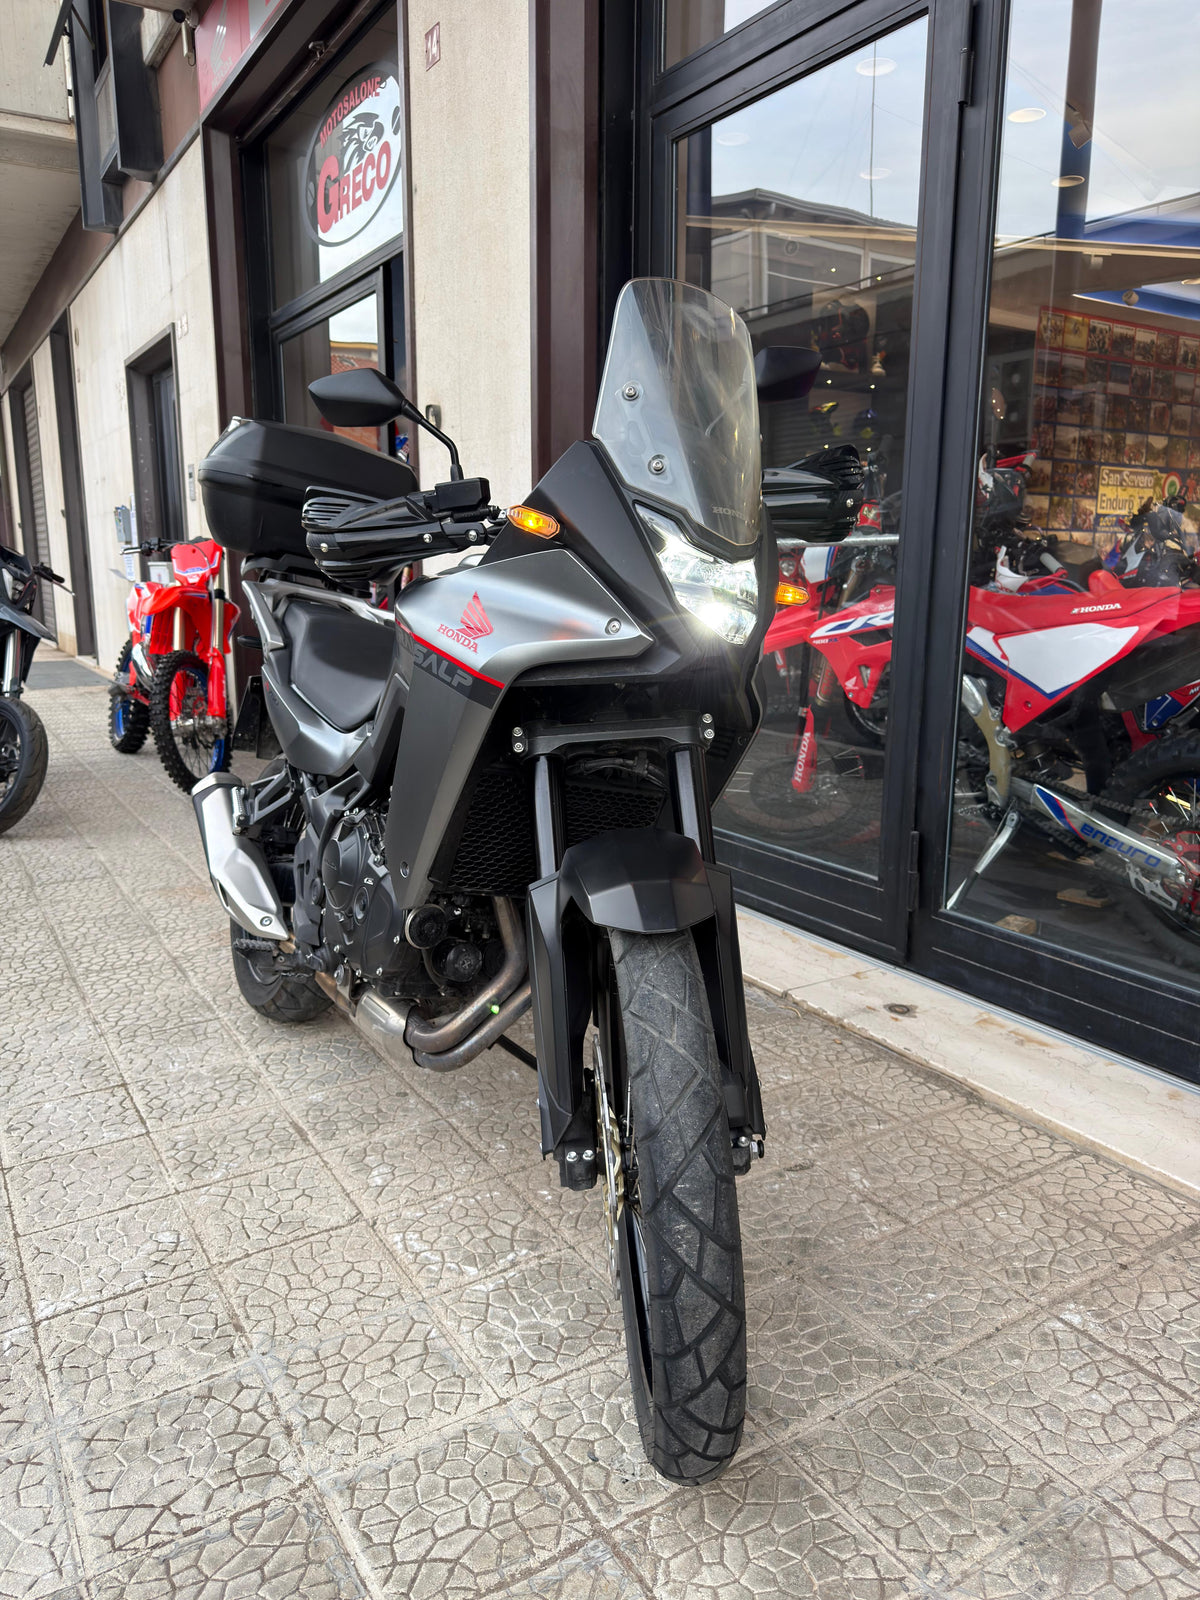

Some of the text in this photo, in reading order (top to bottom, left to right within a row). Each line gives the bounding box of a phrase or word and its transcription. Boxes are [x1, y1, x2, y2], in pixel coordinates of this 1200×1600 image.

[427, 28, 438, 62] 14
[319, 77, 382, 148] MOTOSALONE
[317, 141, 392, 234] GRECO
[1101, 469, 1154, 488] San Severo
[1080, 603, 1122, 613] HONDA
[437, 623, 479, 654] HONDA
[794, 731, 811, 783] HONDA
